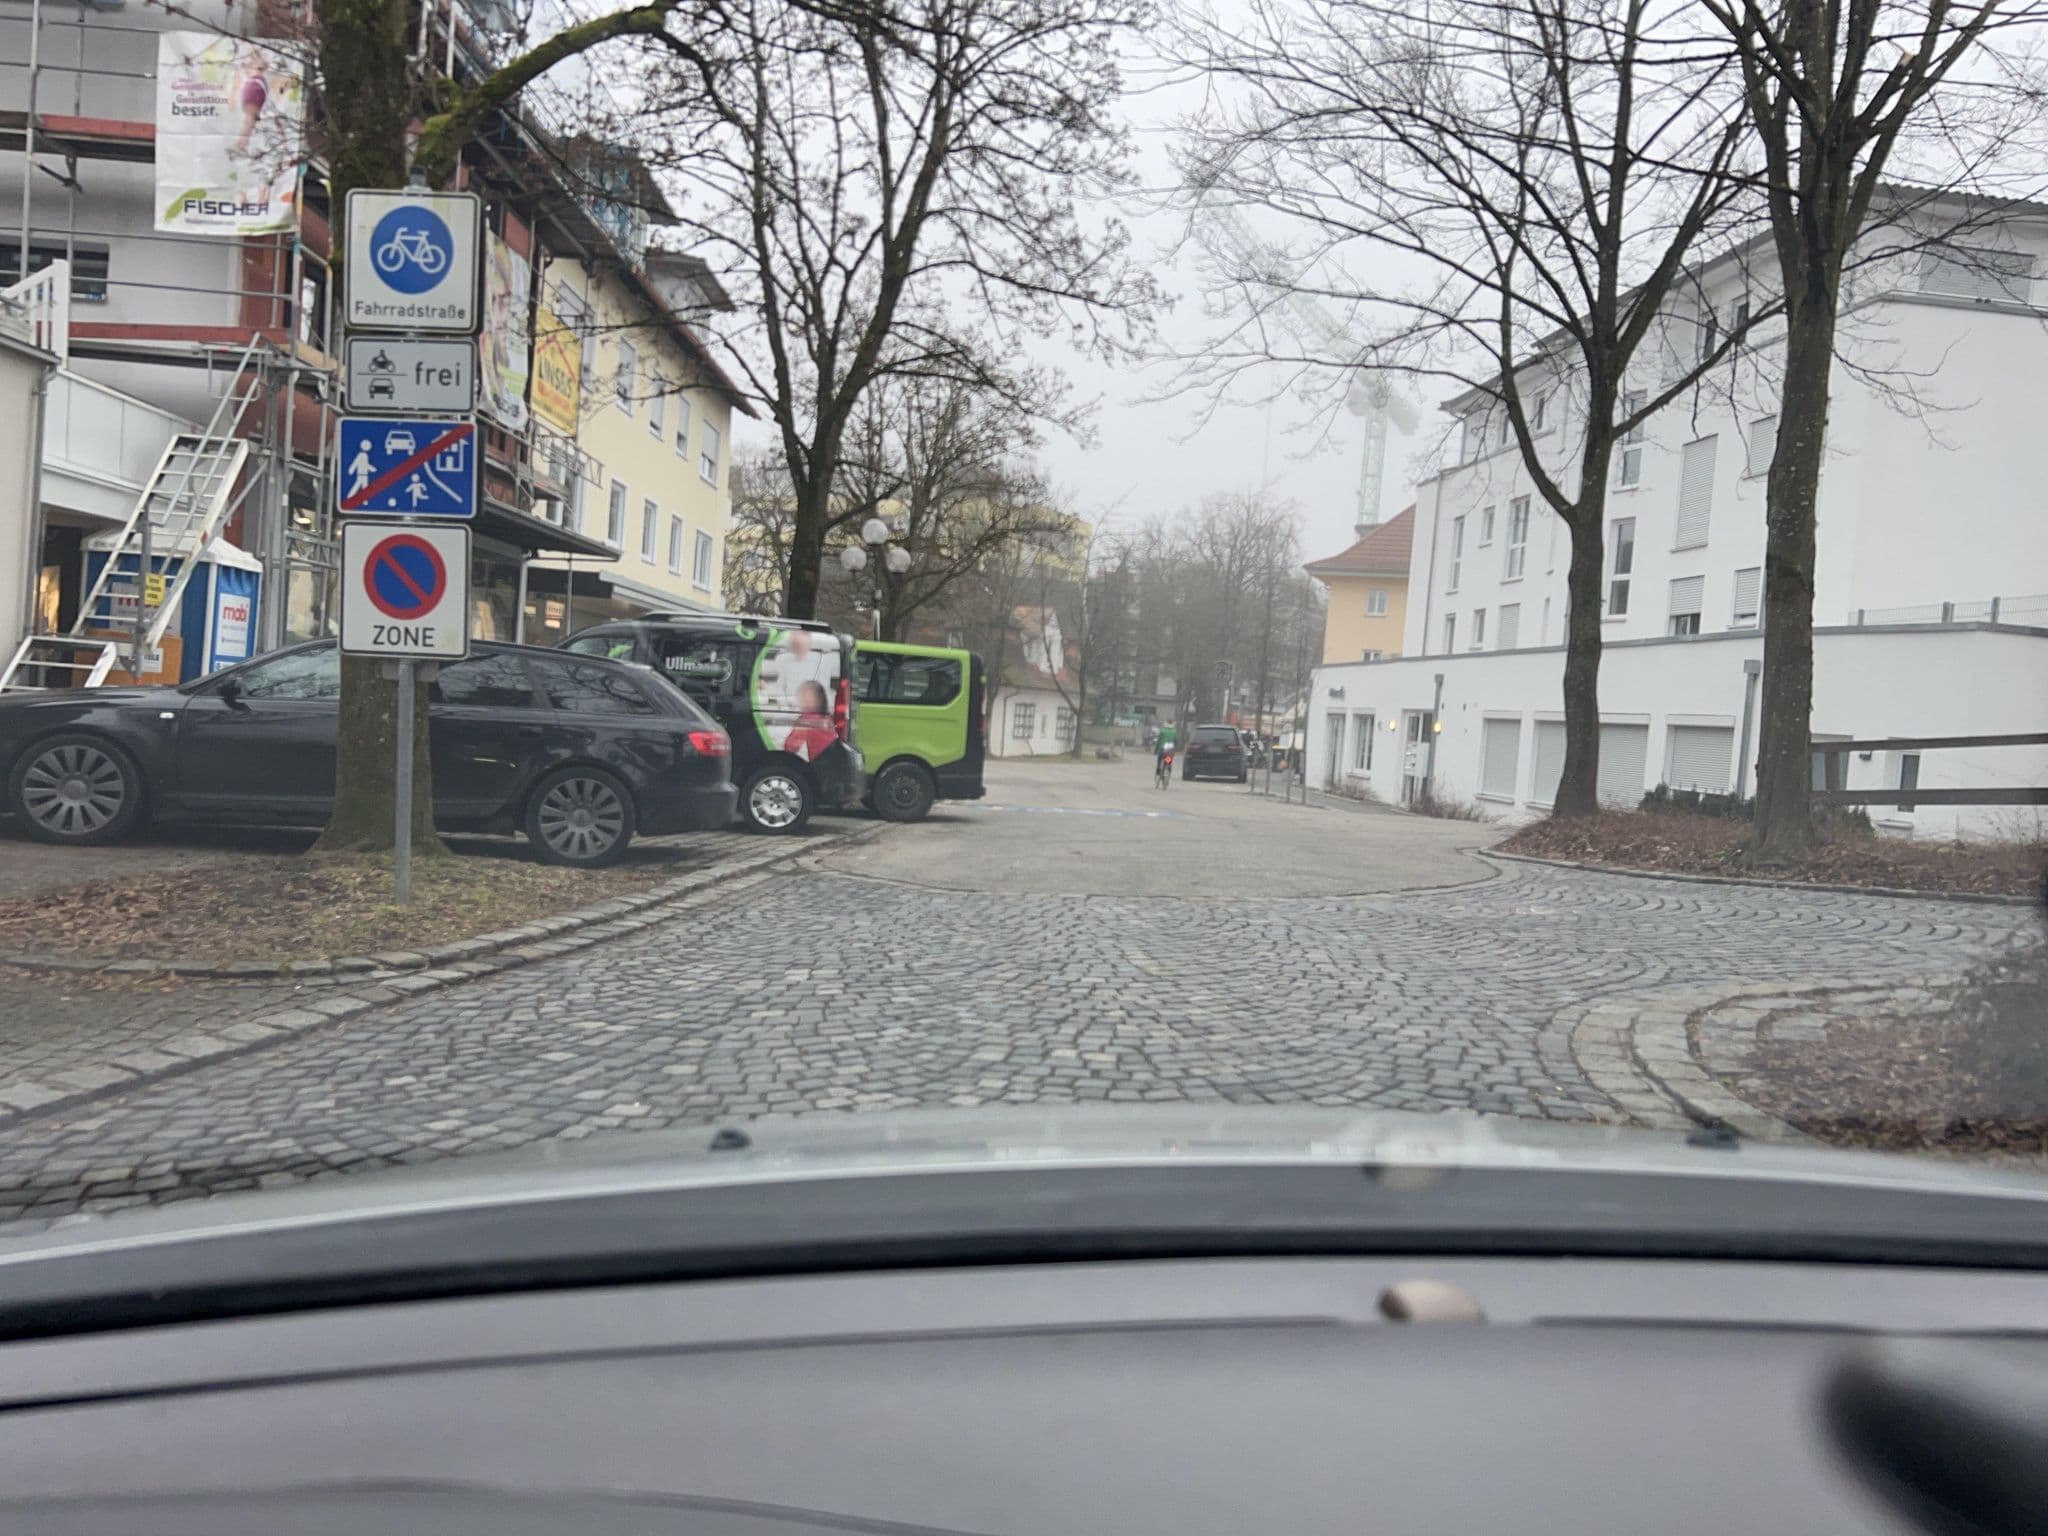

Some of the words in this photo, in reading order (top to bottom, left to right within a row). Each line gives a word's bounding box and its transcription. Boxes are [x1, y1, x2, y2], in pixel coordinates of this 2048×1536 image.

[171, 101, 219, 116] besser.
[184, 199, 270, 216] FISCHER
[354, 300, 466, 320] Fahrradstraße
[415, 360, 461, 387] frei
[372, 625, 436, 648] ZONE
